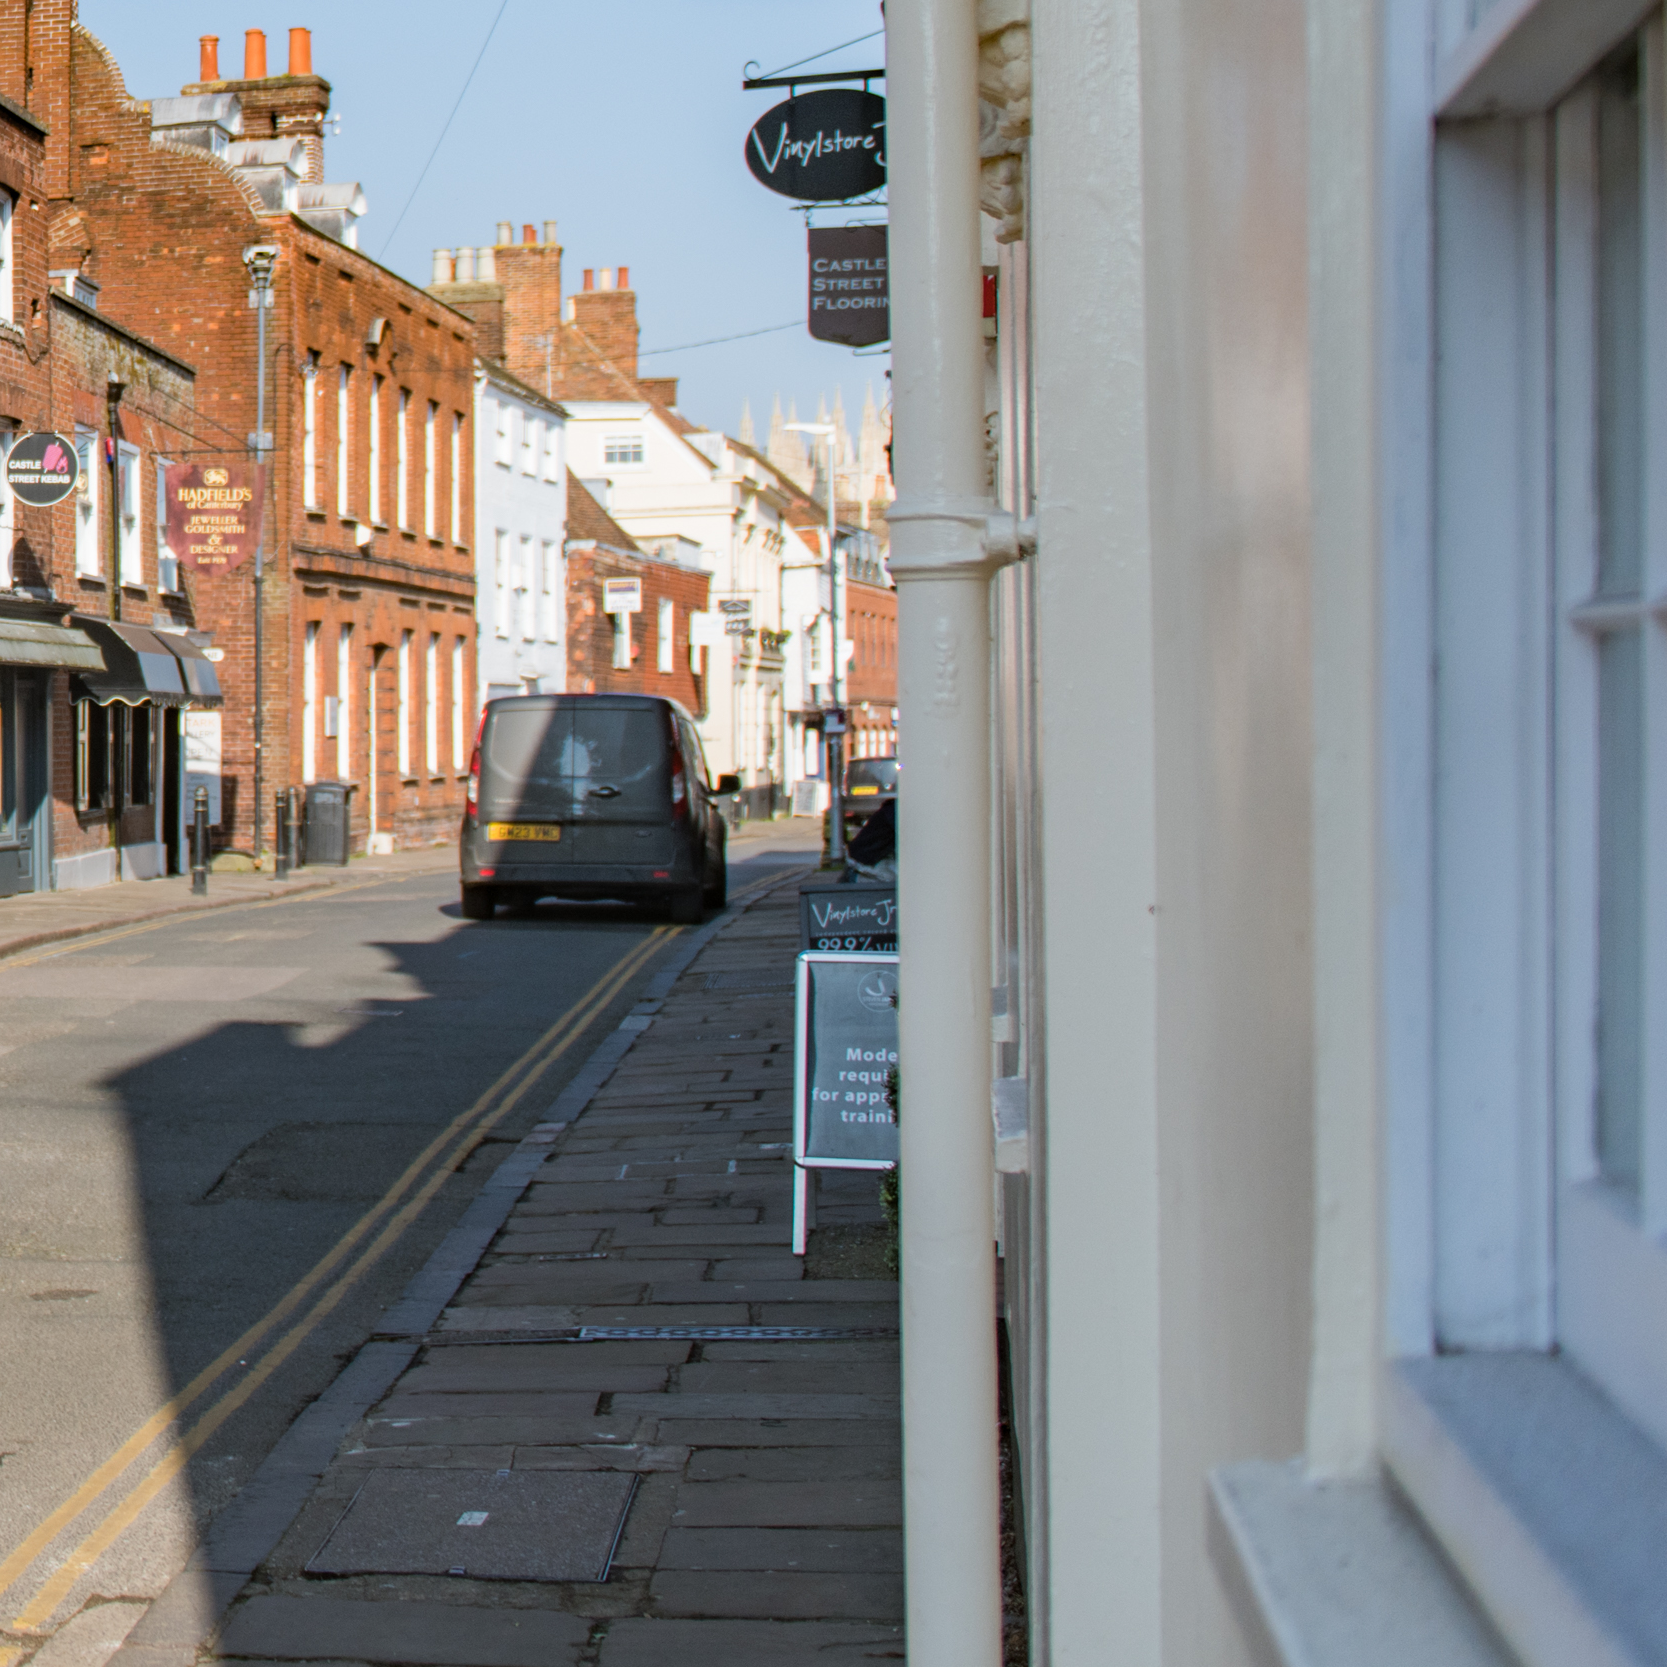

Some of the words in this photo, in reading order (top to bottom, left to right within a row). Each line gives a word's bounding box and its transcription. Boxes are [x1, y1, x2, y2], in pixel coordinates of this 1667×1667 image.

[751, 121, 875, 173] Vinylstore
[812, 258, 886, 273] CASTLE
[812, 277, 885, 292] STREET
[812, 296, 890, 310] FLOORIN
[8, 460, 42, 470] CASTLE
[8, 474, 40, 484] STREET
[40, 474, 71, 484] KEBAB
[177, 487, 253, 502] HADFIELD'S
[185, 501, 197, 510] of
[197, 501, 244, 512] Canterbury
[190, 515, 239, 525] JEWELLER
[184, 524, 246, 534] GOLDSMITH
[207, 533, 224, 546] &
[190, 545, 239, 554] DESIGNER
[186, 718, 216, 727] TARK
[811, 901, 878, 928] Vinylstore
[846, 1047, 898, 1062] Mode
[838, 1068, 888, 1085] requi
[811, 1086, 839, 1101] for
[844, 1090, 888, 1106] appr
[840, 1109, 893, 1123] traini
